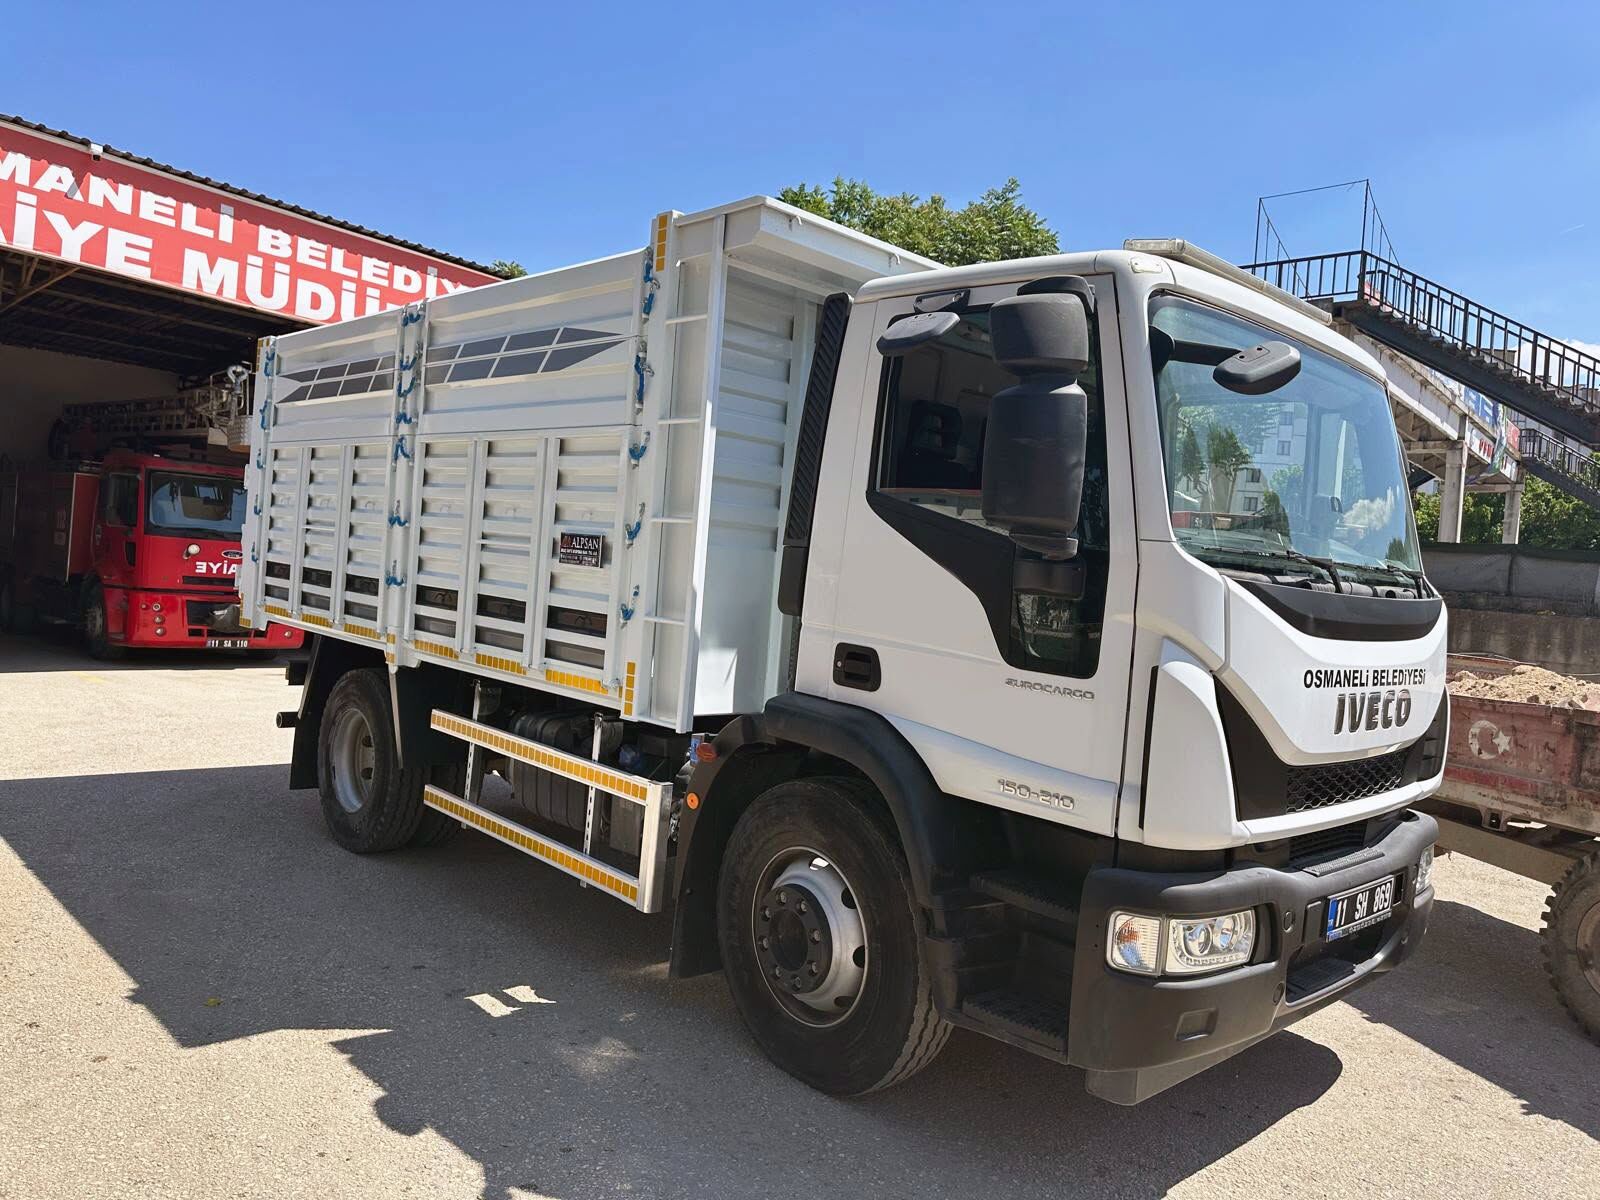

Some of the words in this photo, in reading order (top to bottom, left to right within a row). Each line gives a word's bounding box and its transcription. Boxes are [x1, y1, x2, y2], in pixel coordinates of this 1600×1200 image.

[0, 190, 153, 281] İYE
[181, 247, 403, 323] MÜDÜ
[571, 536, 599, 550] ALPSAN
[1005, 677, 1095, 700] EUROCARGO
[1333, 688, 1412, 735] IVECO
[998, 778, 1075, 811] 150-210
[1335, 899, 1348, 928] 11
[1354, 890, 1370, 921] SH
[1372, 882, 1391, 913] 869
